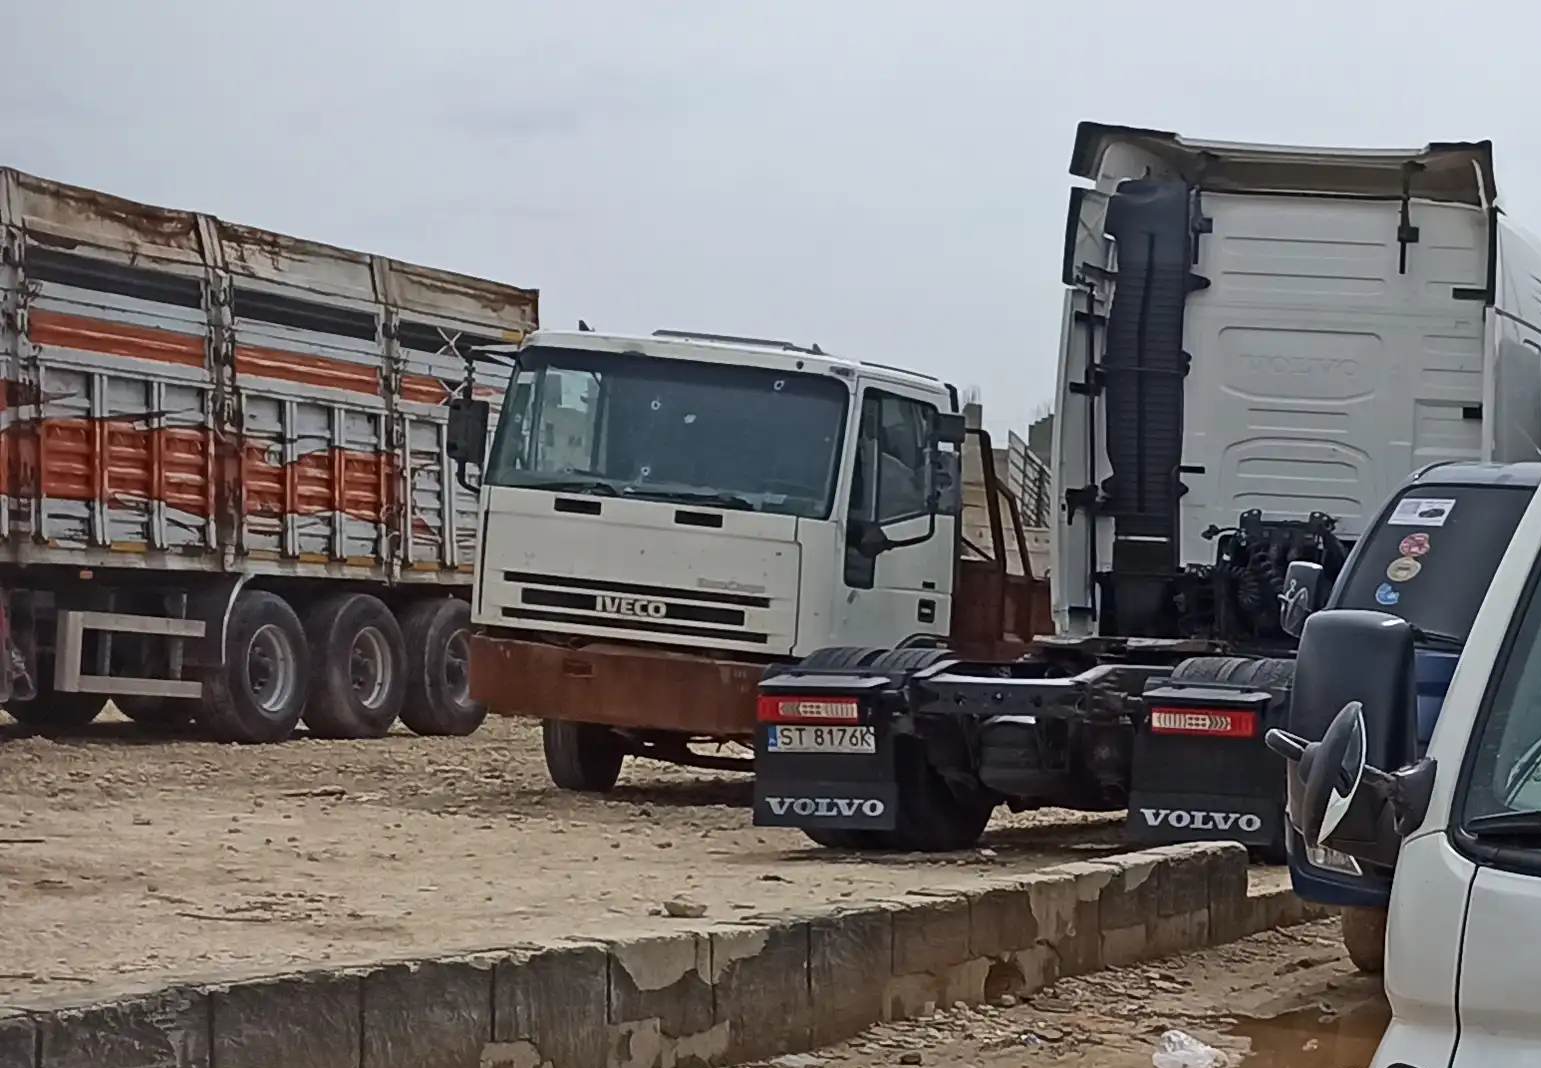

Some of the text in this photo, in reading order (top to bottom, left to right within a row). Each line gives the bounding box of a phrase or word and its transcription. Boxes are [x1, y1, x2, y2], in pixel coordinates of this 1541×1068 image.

[595, 595, 667, 618] IVECO
[780, 728, 806, 746] ST
[814, 728, 871, 747] 8176K
[765, 797, 885, 816] VOLVO
[1140, 808, 1262, 831] VOLVO
